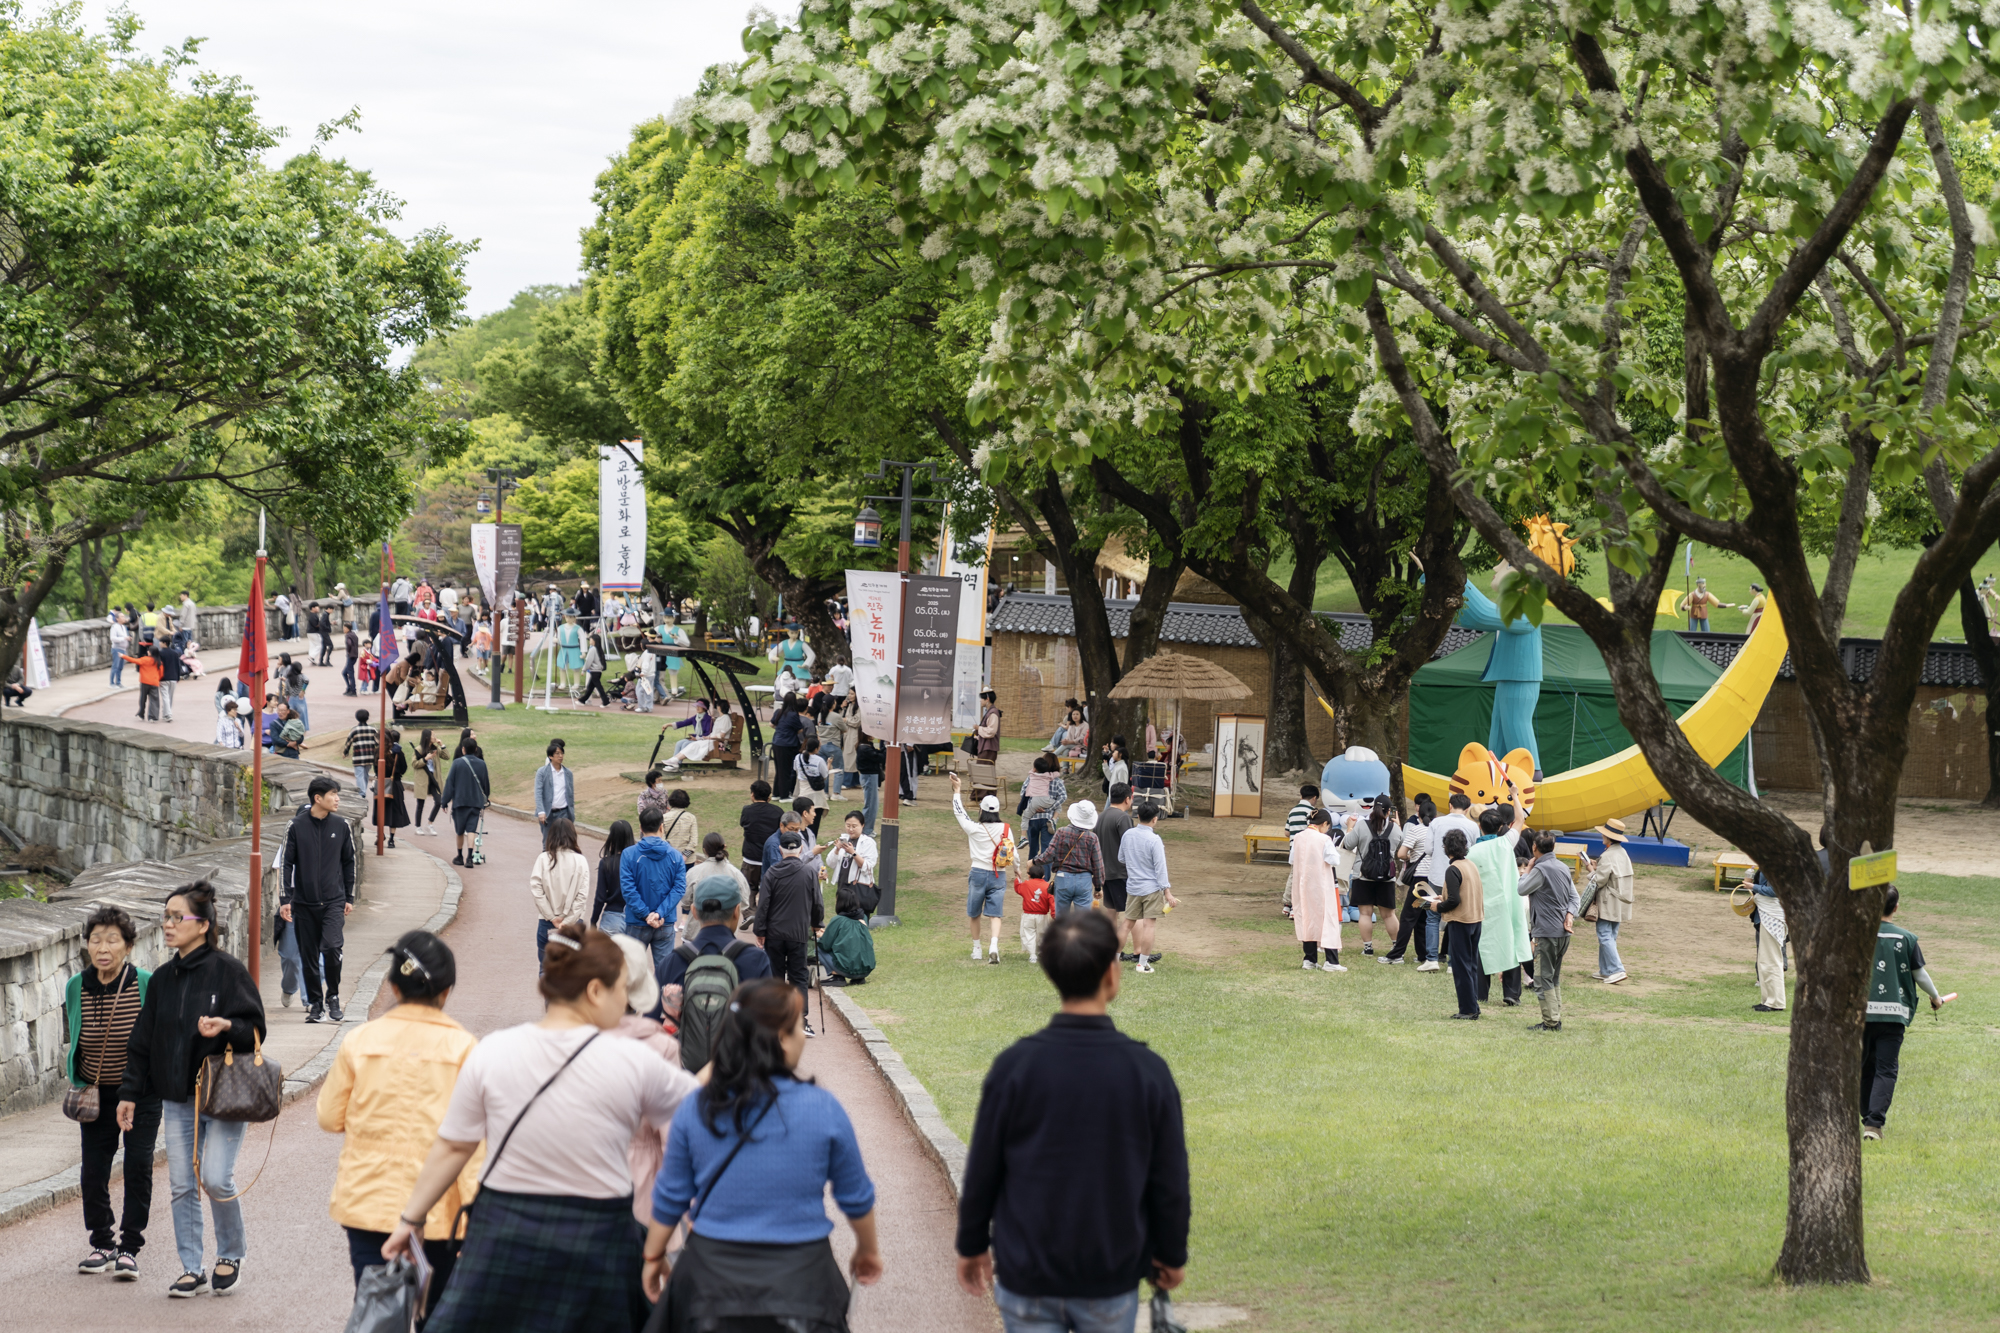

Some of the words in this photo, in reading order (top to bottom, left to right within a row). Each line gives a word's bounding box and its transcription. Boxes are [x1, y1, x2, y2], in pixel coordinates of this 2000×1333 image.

[617, 460, 631, 538] 교방문화로
[617, 544, 631, 576] 놀장
[867, 602, 884, 611] 진주
[869, 613, 885, 661] 논개제
[901, 725, 924, 735] 새로운
[905, 715, 926, 724] 청춘의
